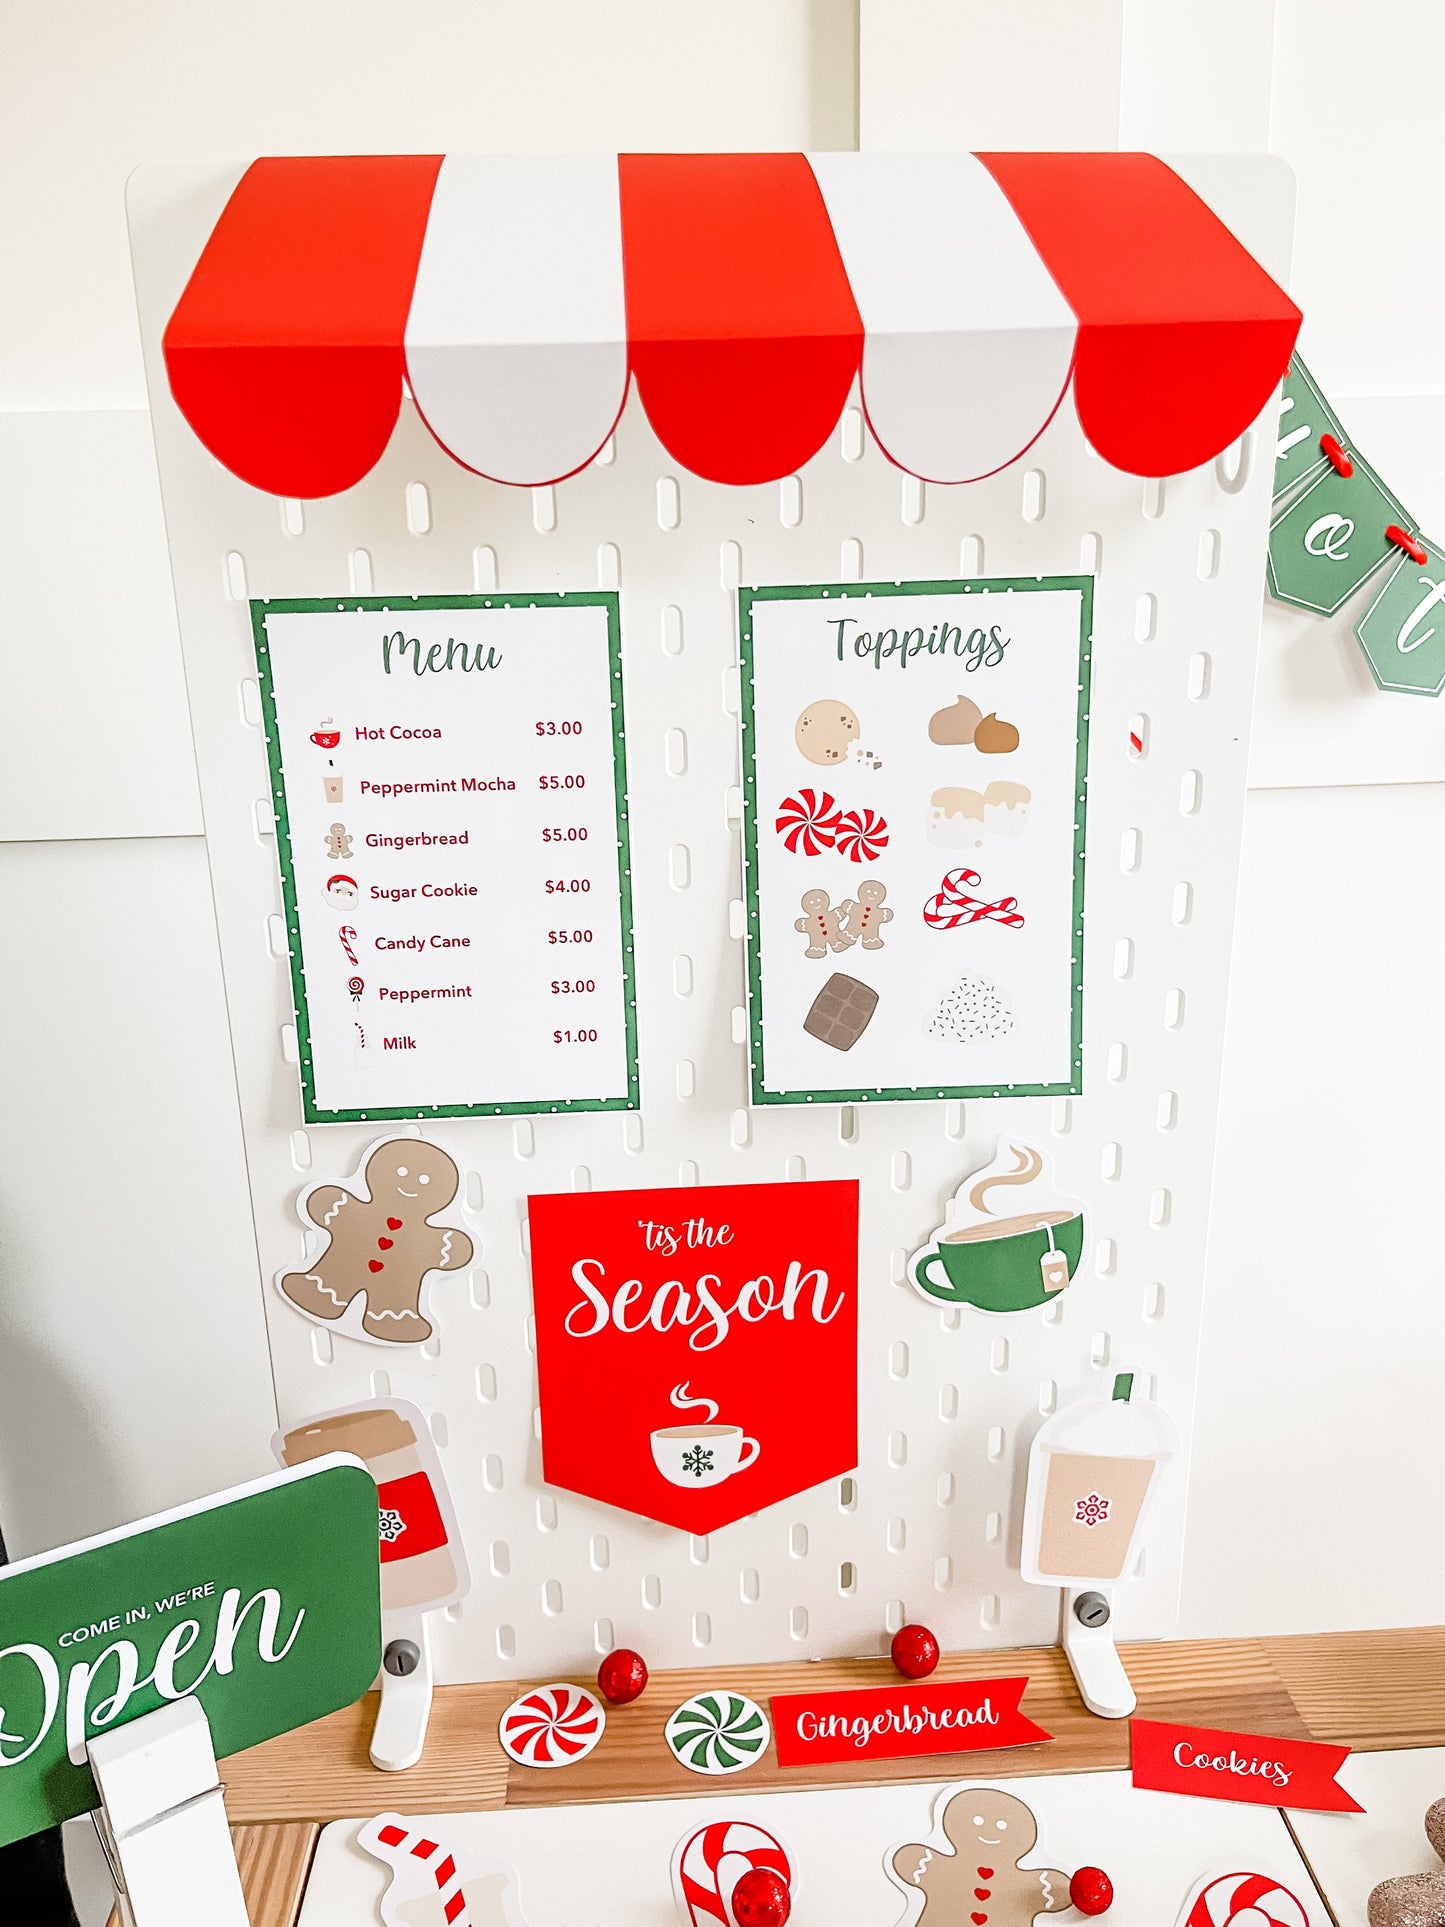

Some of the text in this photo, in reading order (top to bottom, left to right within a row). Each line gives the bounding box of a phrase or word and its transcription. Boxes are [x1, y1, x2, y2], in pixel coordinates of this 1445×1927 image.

[383, 631, 502, 676] Menu
[826, 619, 1011, 672] Toppings
[356, 721, 582, 740] Hot Cocoa $3.00
[361, 775, 585, 797] Peppermint Mocha $5.00
[366, 828, 587, 850] Gingerbread $5.00
[371, 879, 590, 902] Sugar Cookie $4.00
[375, 930, 592, 952] Candy Cane $5.00
[380, 980, 595, 1003] Peppermint $3.00
[384, 1029, 597, 1050] Milk $1.00
[638, 1217, 734, 1255] 'tis the
[565, 1258, 844, 1351] Season
[58, 1582, 216, 1648] COME IN, WE'RE
[798, 1699, 998, 1746] Gingerbread
[1174, 1743, 1292, 1786] Cookies
